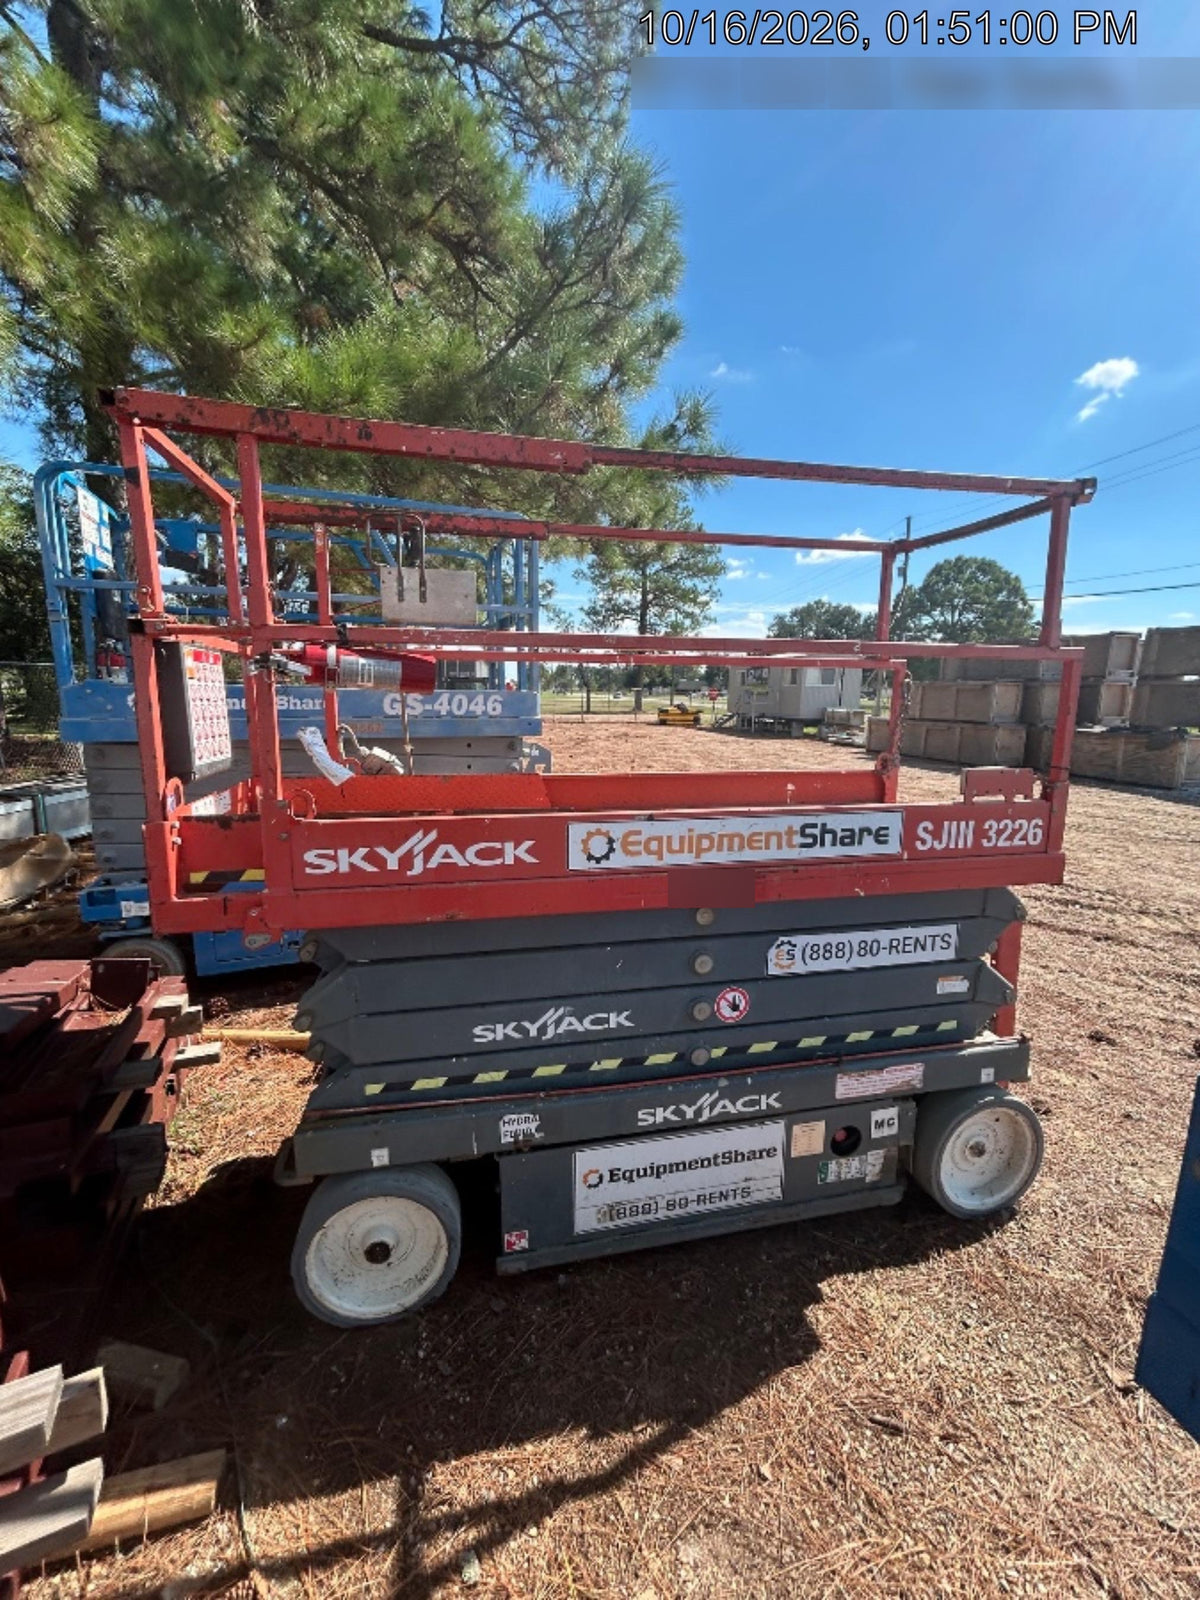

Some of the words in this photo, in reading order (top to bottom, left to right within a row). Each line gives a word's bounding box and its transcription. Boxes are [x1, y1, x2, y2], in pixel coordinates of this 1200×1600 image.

[382, 692, 504, 717] GS-4046
[620, 822, 890, 861] EquipmentShare
[981, 818, 1043, 847] 3226
[303, 828, 540, 877] SKYJACK
[801, 939, 853, 966] (888)
[857, 933, 952, 957] 80-RENTS
[472, 1005, 635, 1043] SKYJACK
[637, 1090, 782, 1126] SKYJACK
[608, 1145, 778, 1184] EquipmentShare
[666, 1186, 752, 1212] 80-RENTS
